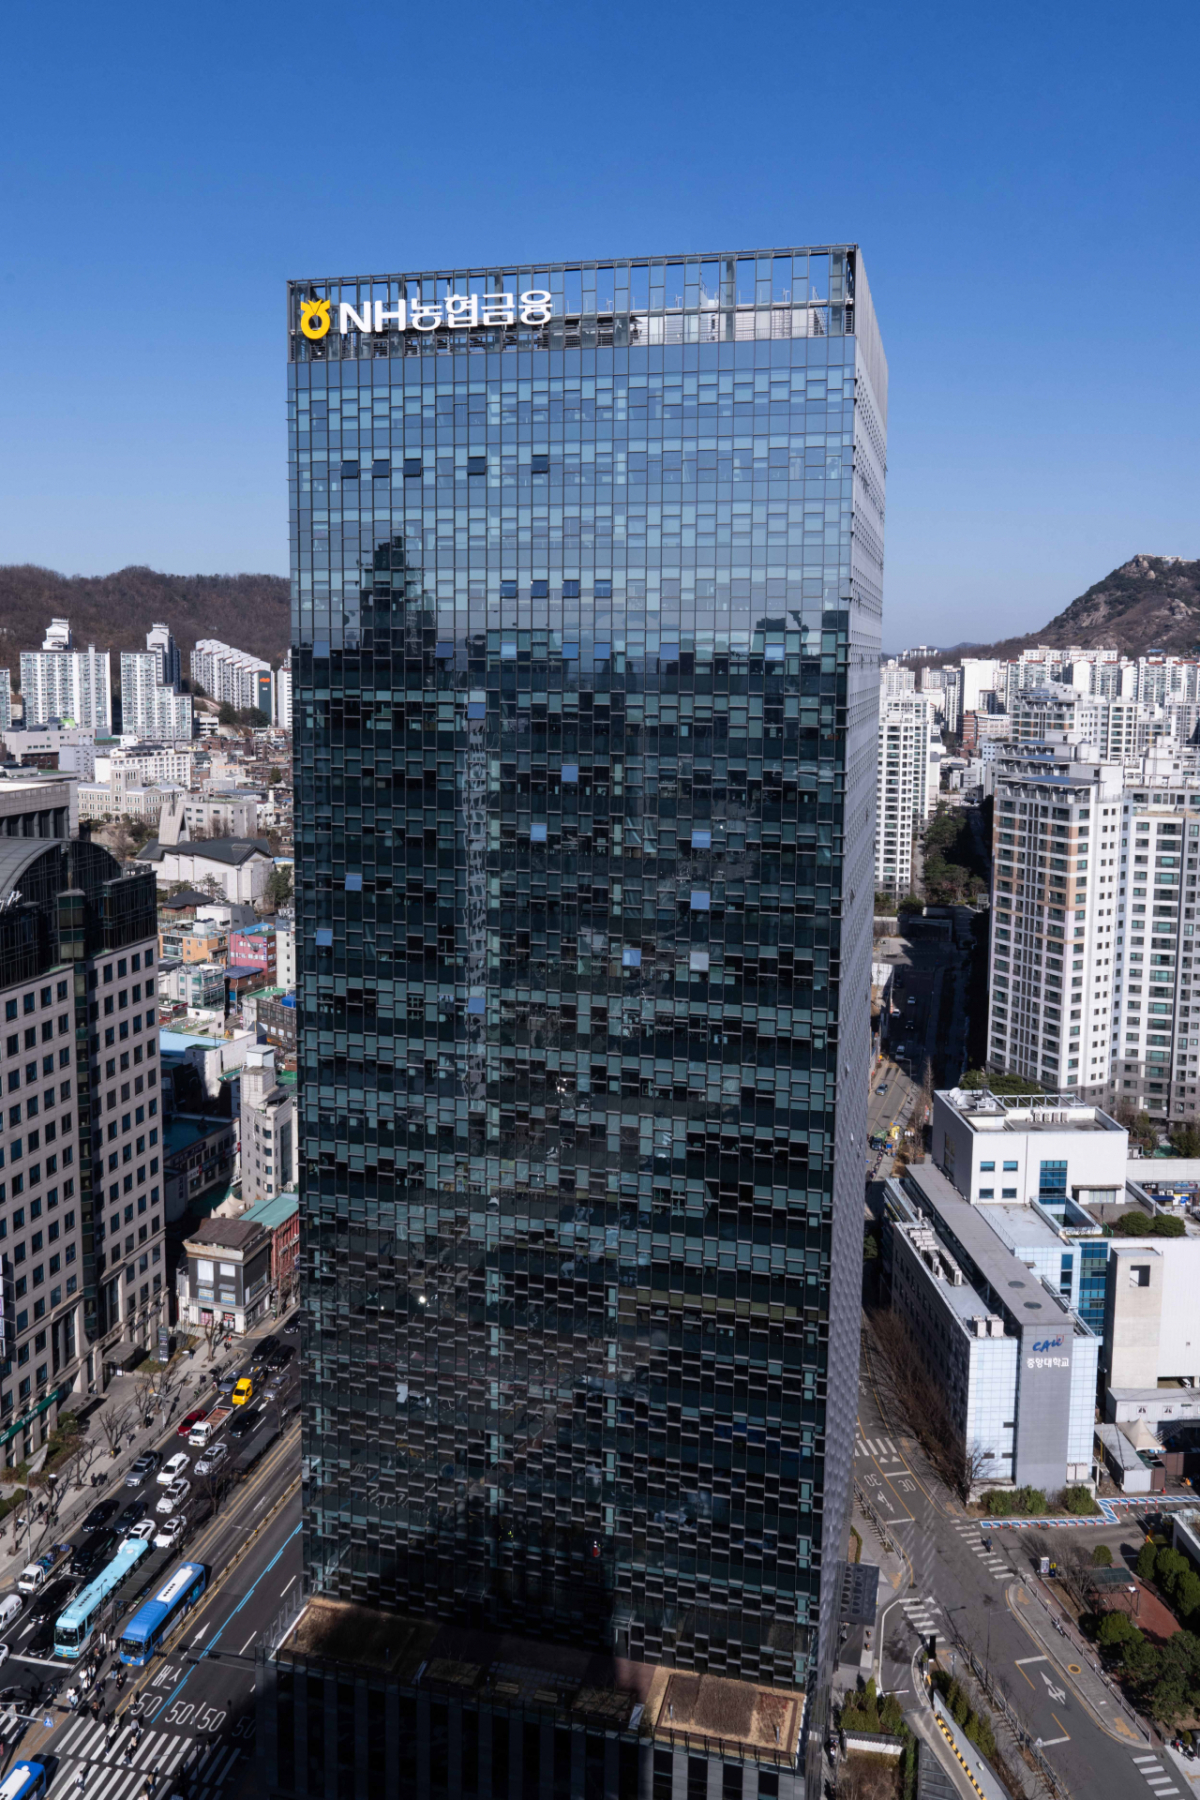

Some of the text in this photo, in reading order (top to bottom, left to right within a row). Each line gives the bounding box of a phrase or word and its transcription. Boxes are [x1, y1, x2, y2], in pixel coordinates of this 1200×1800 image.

[1026, 1357, 1070, 1369] 중앙대학교
[897, 1478, 917, 1493] 30
[152, 1665, 182, 1689] 버스
[131, 1692, 163, 1717] 50
[165, 1700, 194, 1725] 50
[197, 1707, 227, 1732] 50
